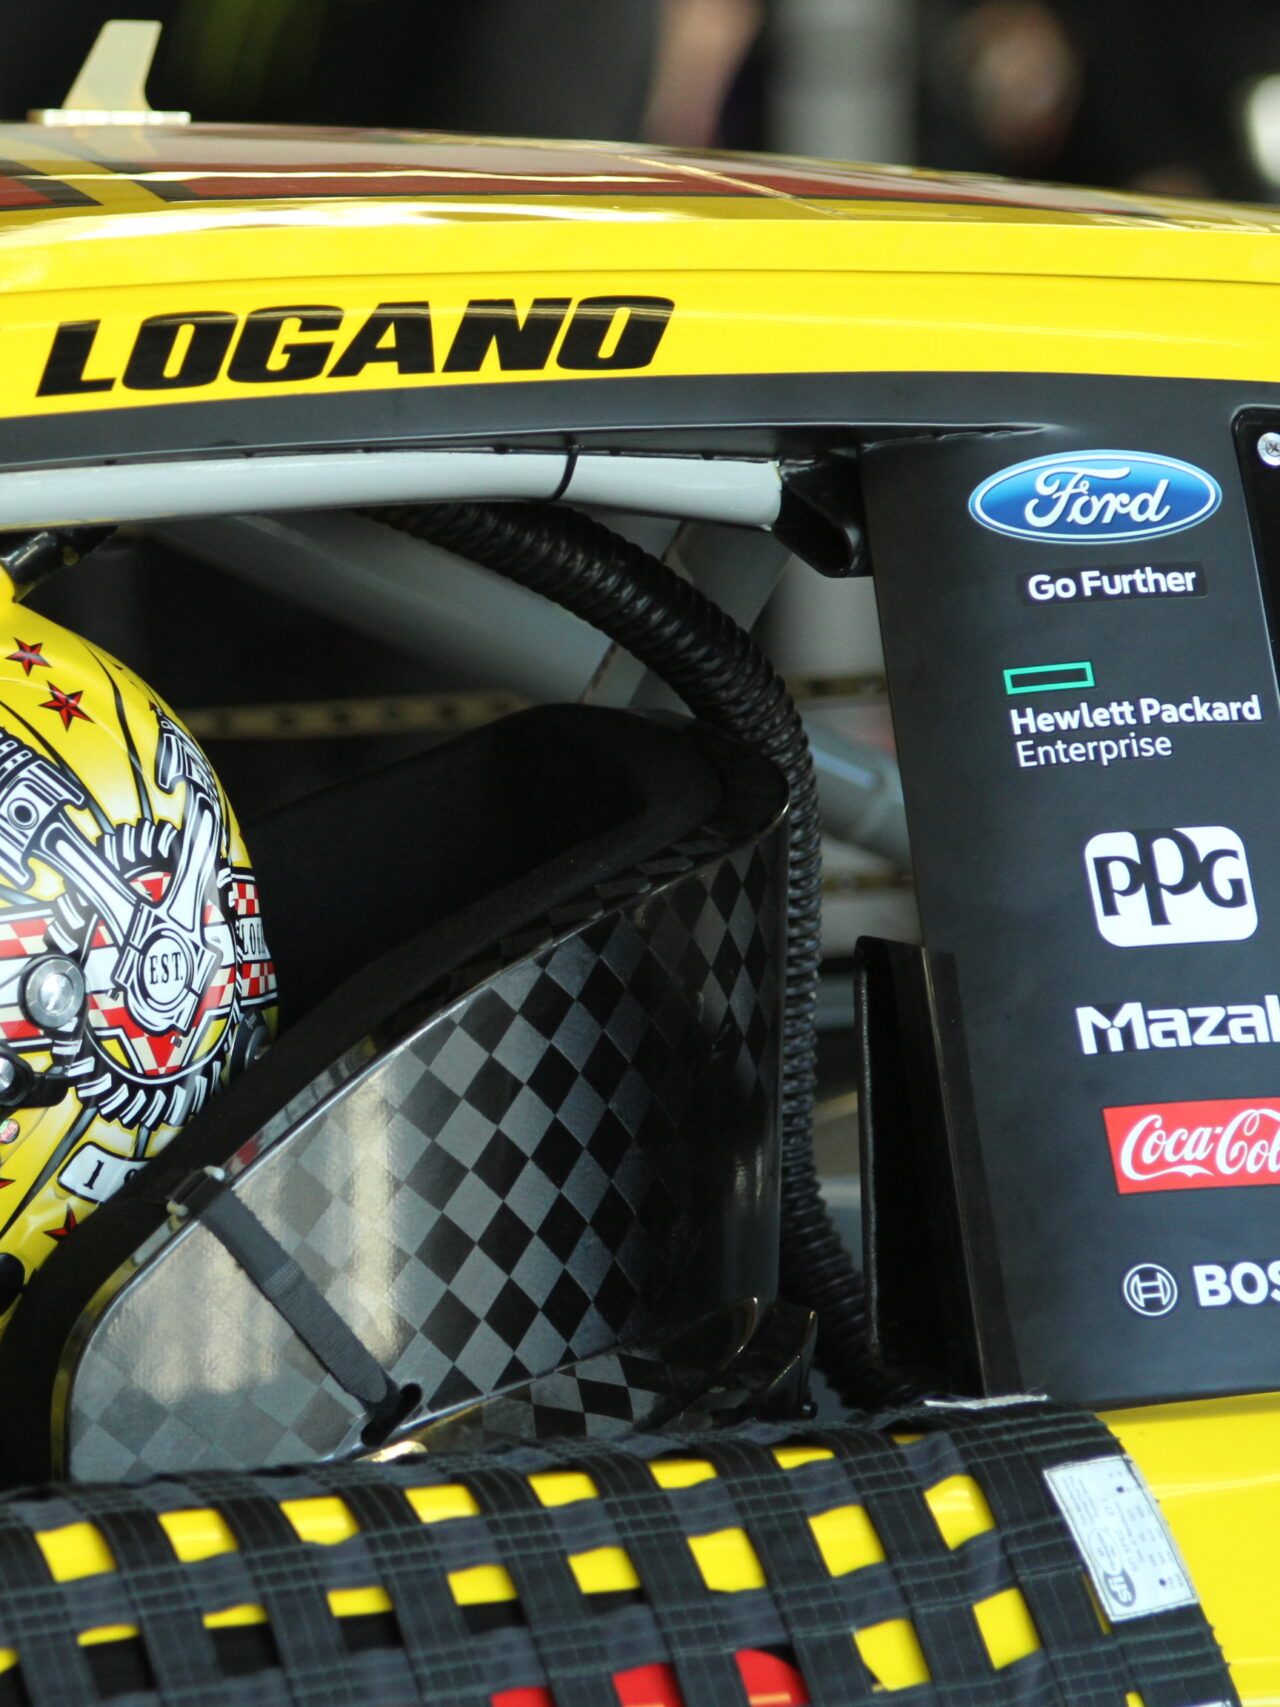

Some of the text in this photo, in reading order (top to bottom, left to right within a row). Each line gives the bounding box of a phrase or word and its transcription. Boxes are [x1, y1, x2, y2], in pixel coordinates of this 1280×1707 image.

[37, 297, 674, 396] LOGANO
[1024, 466, 1170, 528] Ford
[1028, 566, 1197, 600] Go Further
[1010, 695, 1262, 735] Hewlett Packard
[1016, 732, 1173, 768] Enterprise
[1094, 828, 1248, 925] PPG
